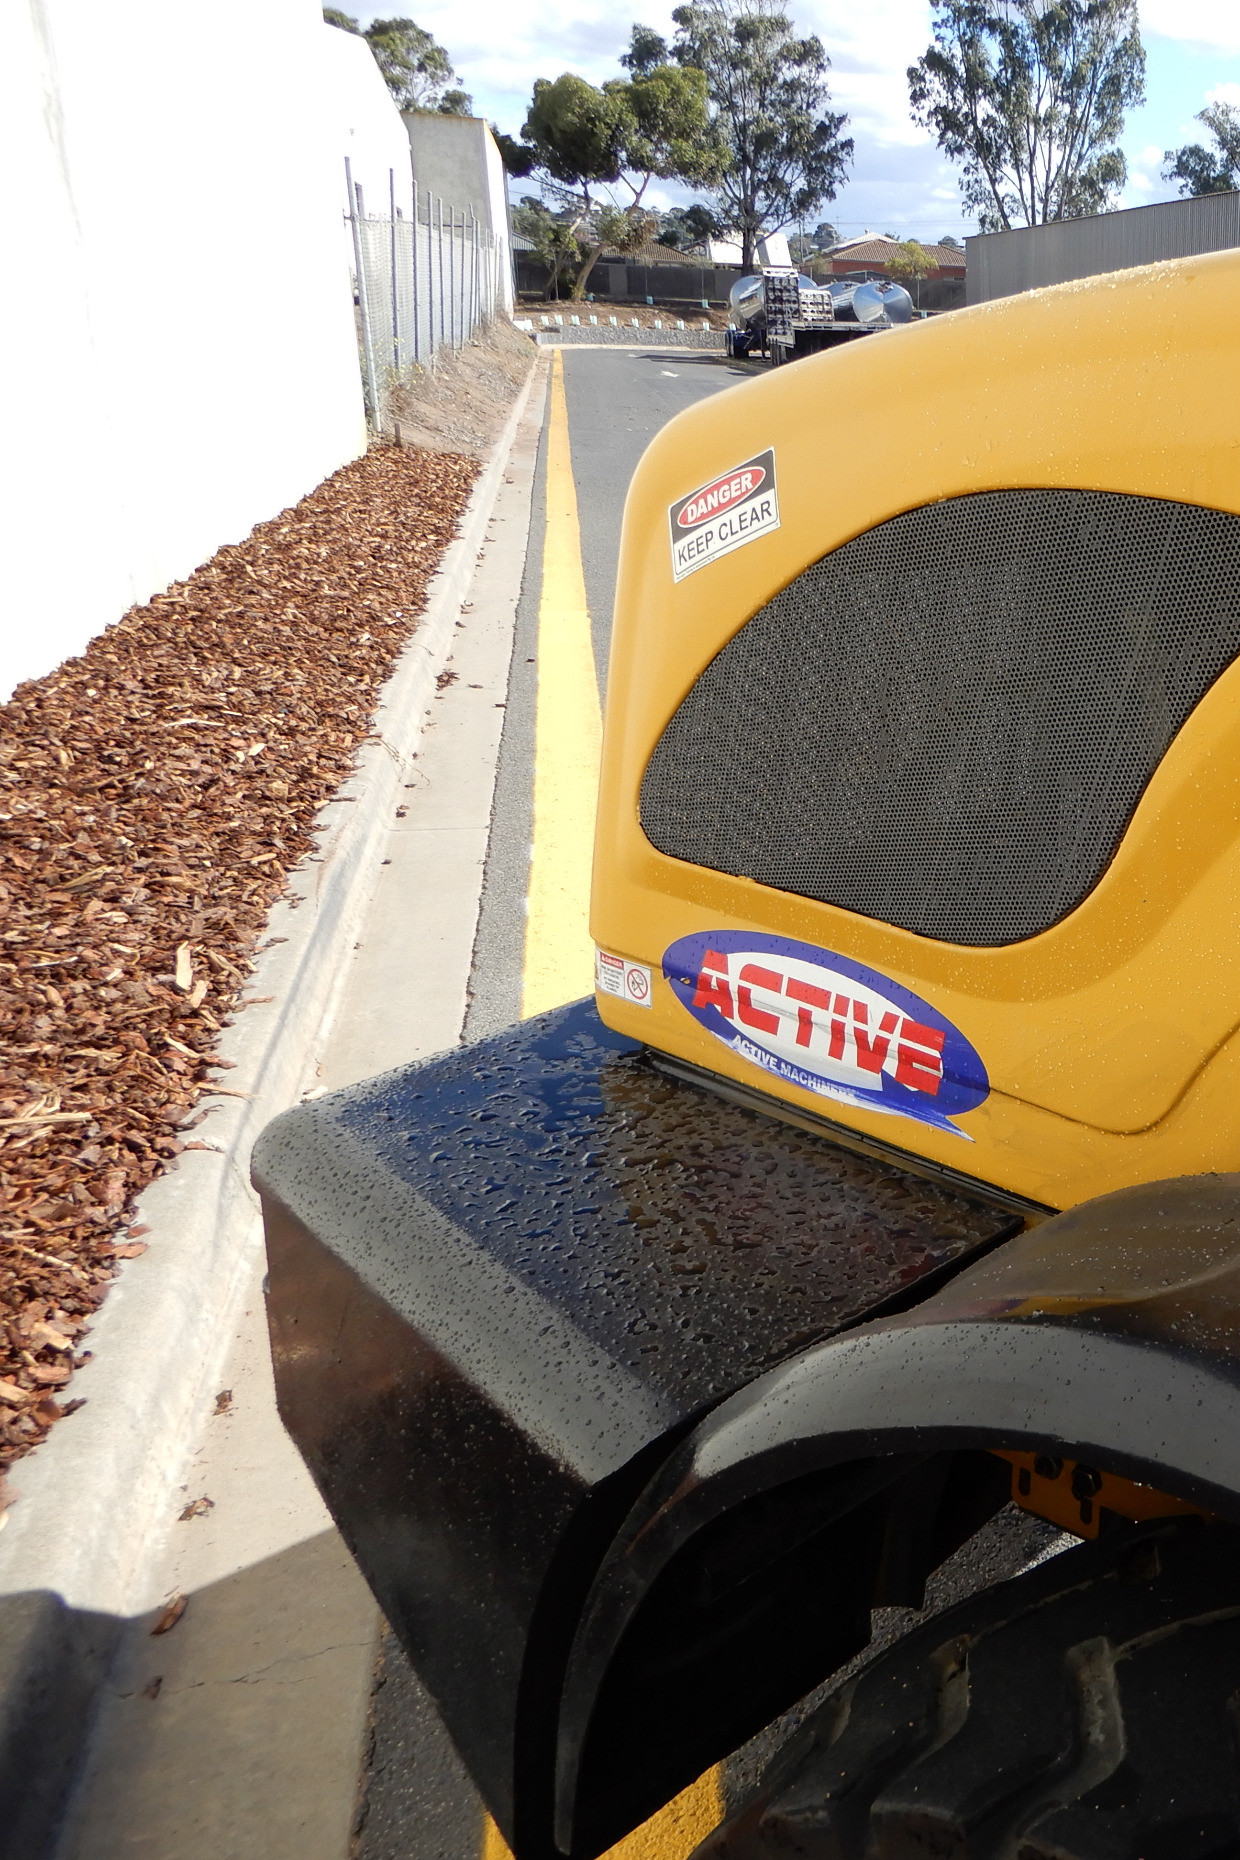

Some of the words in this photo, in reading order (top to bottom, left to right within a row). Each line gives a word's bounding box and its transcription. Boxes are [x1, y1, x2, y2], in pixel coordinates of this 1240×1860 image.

[687, 472, 753, 524] DANGER
[678, 530, 713, 566] KEEP
[718, 500, 772, 541] CLEAR
[693, 949, 946, 1096] ACTIVE
[732, 1034, 778, 1070] ACTIVE
